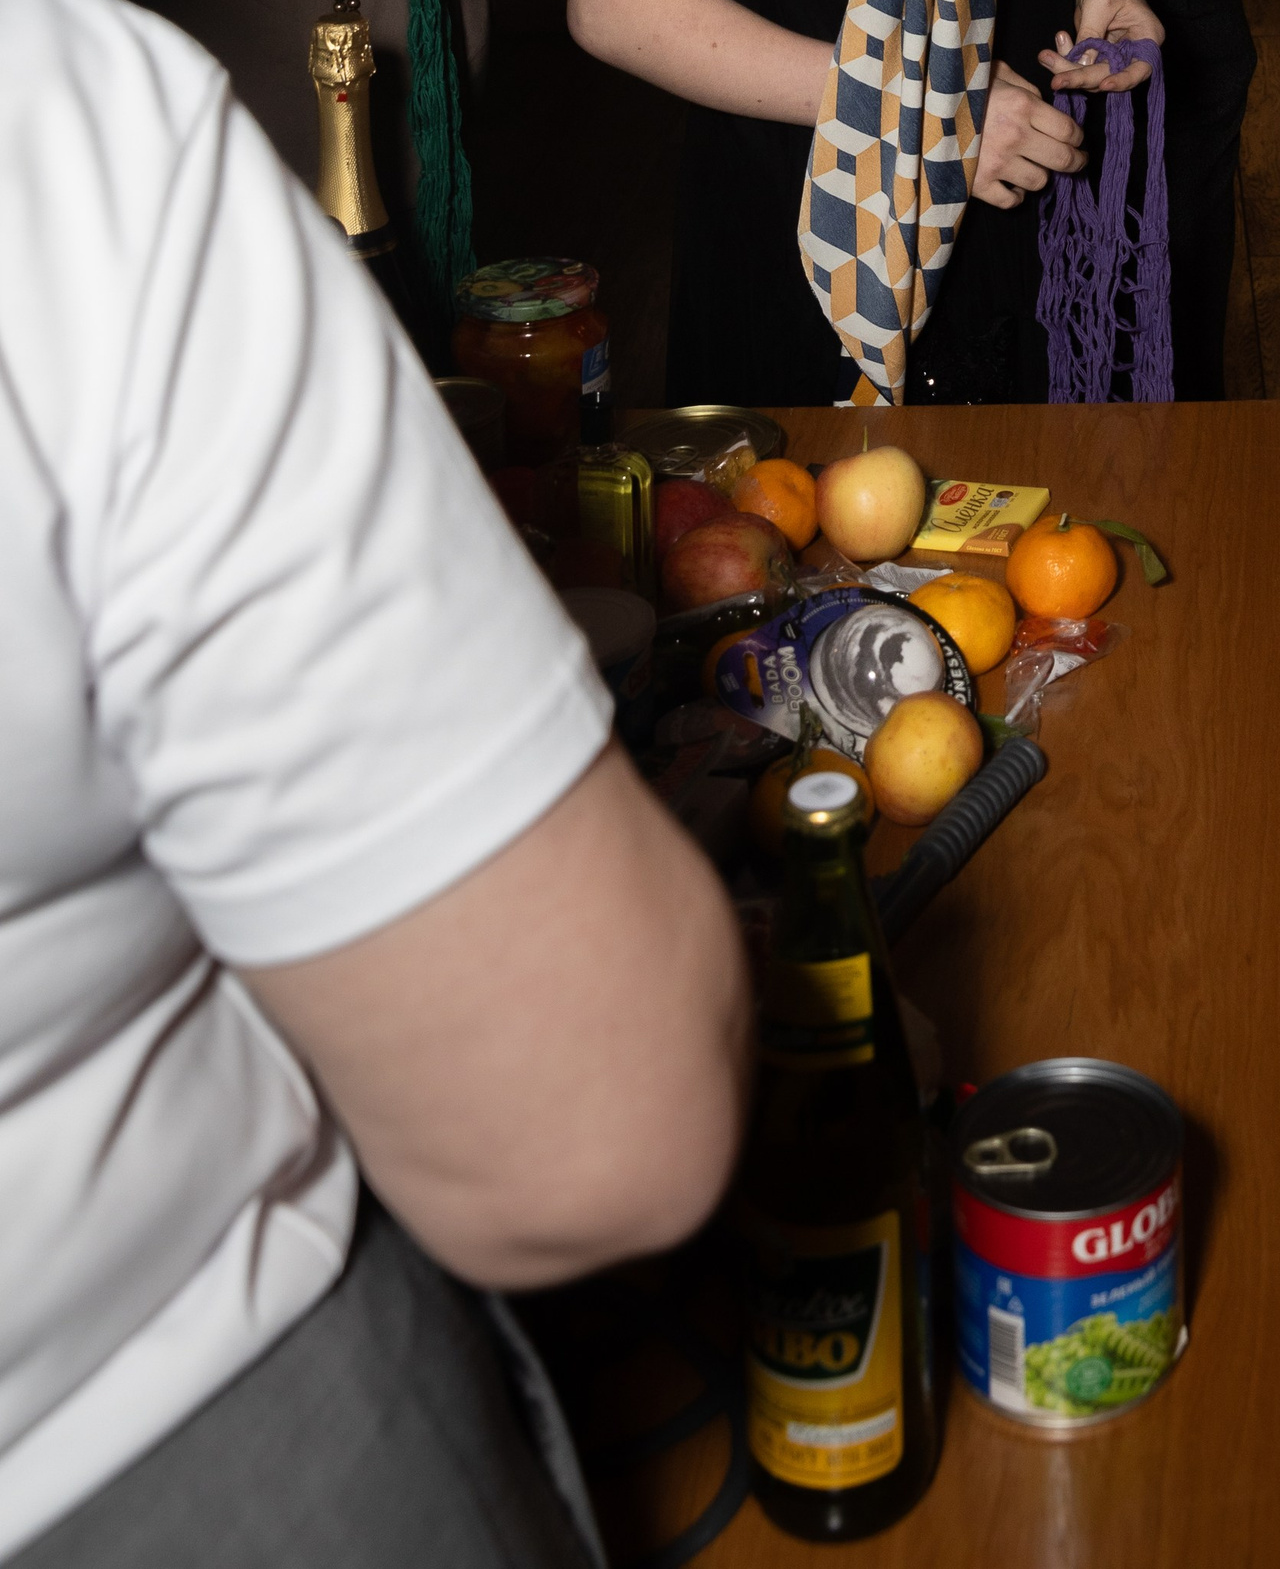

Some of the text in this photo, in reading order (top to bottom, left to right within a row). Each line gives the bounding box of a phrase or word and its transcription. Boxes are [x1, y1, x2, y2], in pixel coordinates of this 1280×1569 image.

[764, 653, 784, 705] BADA
[777, 644, 803, 715] BOOM
[1072, 1179, 1177, 1265] GLOB
